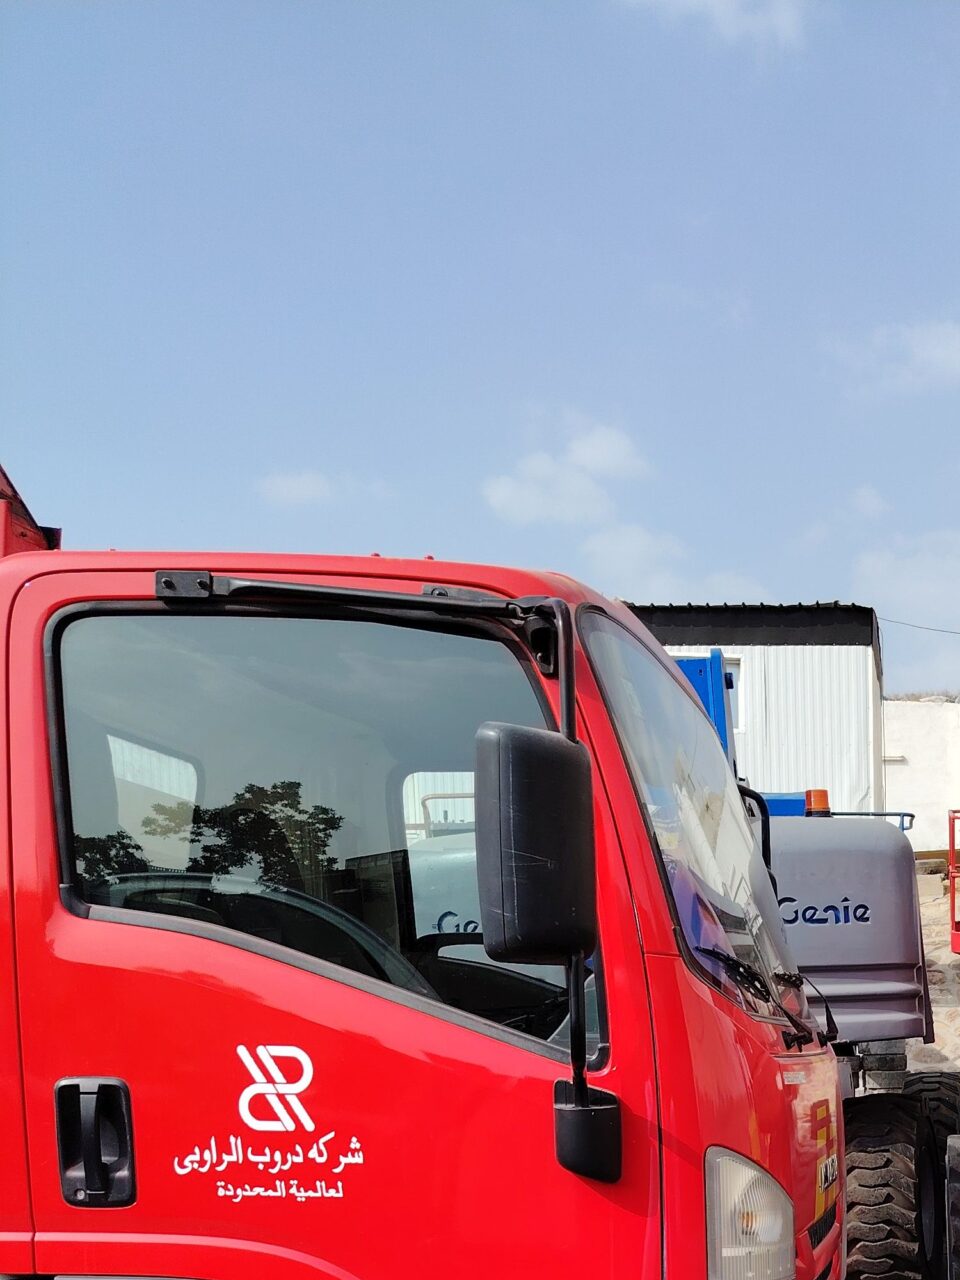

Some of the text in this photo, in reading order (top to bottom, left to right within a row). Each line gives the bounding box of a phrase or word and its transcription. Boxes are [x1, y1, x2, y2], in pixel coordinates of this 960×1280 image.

[777, 896, 871, 924] Genie
[247, 1143, 304, 1174] دروب
[216, 1179, 286, 1203] المحدودة
